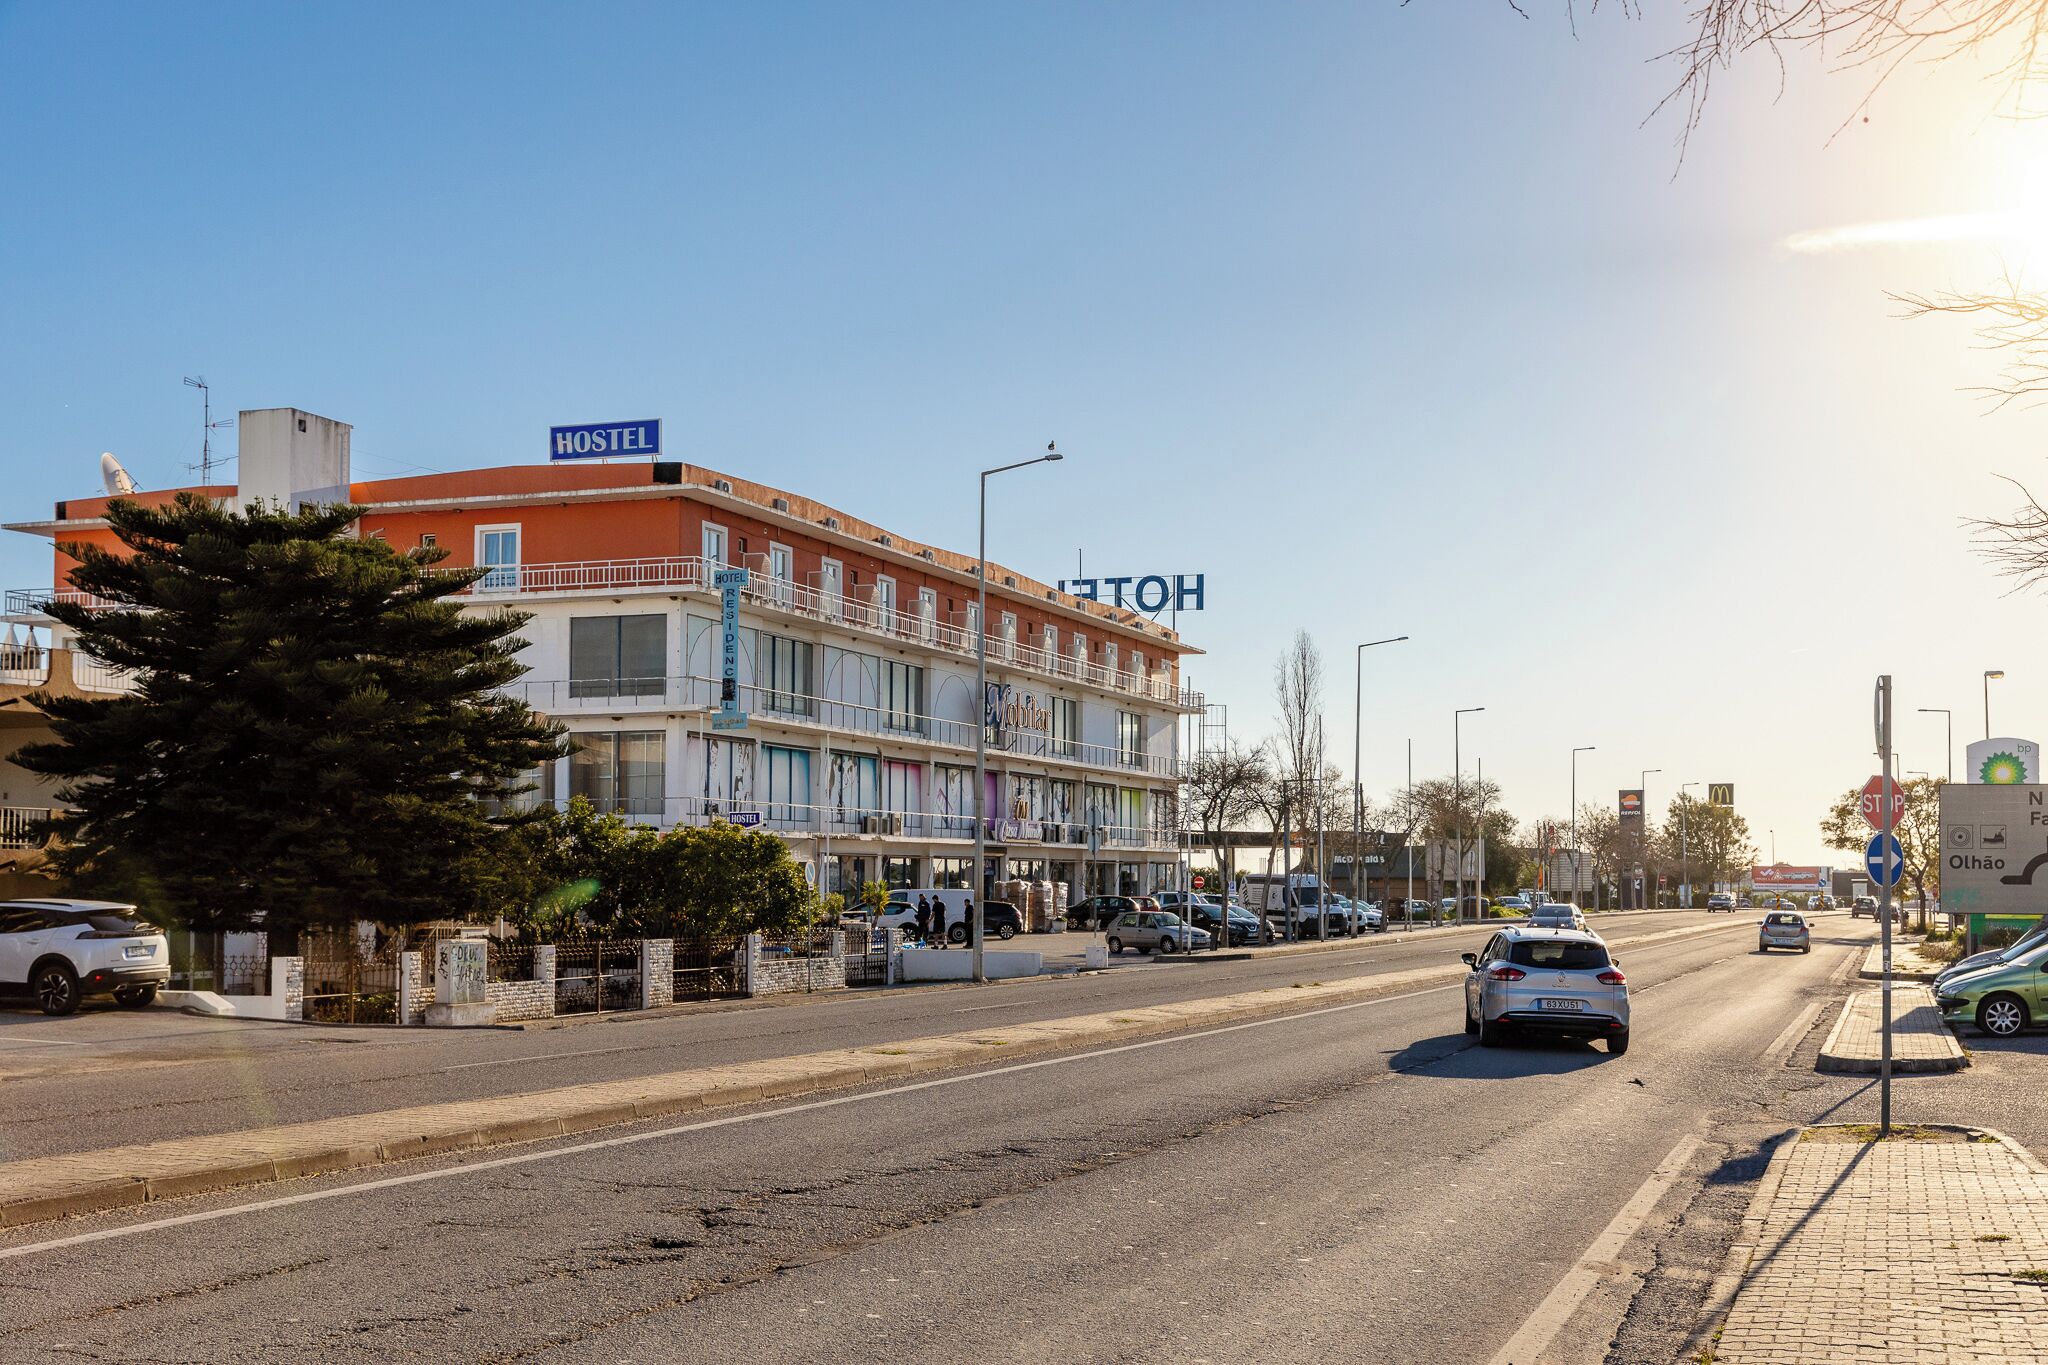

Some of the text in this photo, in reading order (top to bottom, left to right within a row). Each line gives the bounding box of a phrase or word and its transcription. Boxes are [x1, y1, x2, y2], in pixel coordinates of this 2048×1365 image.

[556, 427, 653, 454] HOSTEL
[715, 572, 746, 585] HOTEL
[724, 588, 736, 711] RESIDENCL
[2017, 743, 2032, 754] bp
[1863, 793, 1904, 813] STP
[2029, 791, 2043, 806] N
[731, 814, 758, 824] HOSTEL
[1949, 854, 2005, 870] Olhão
